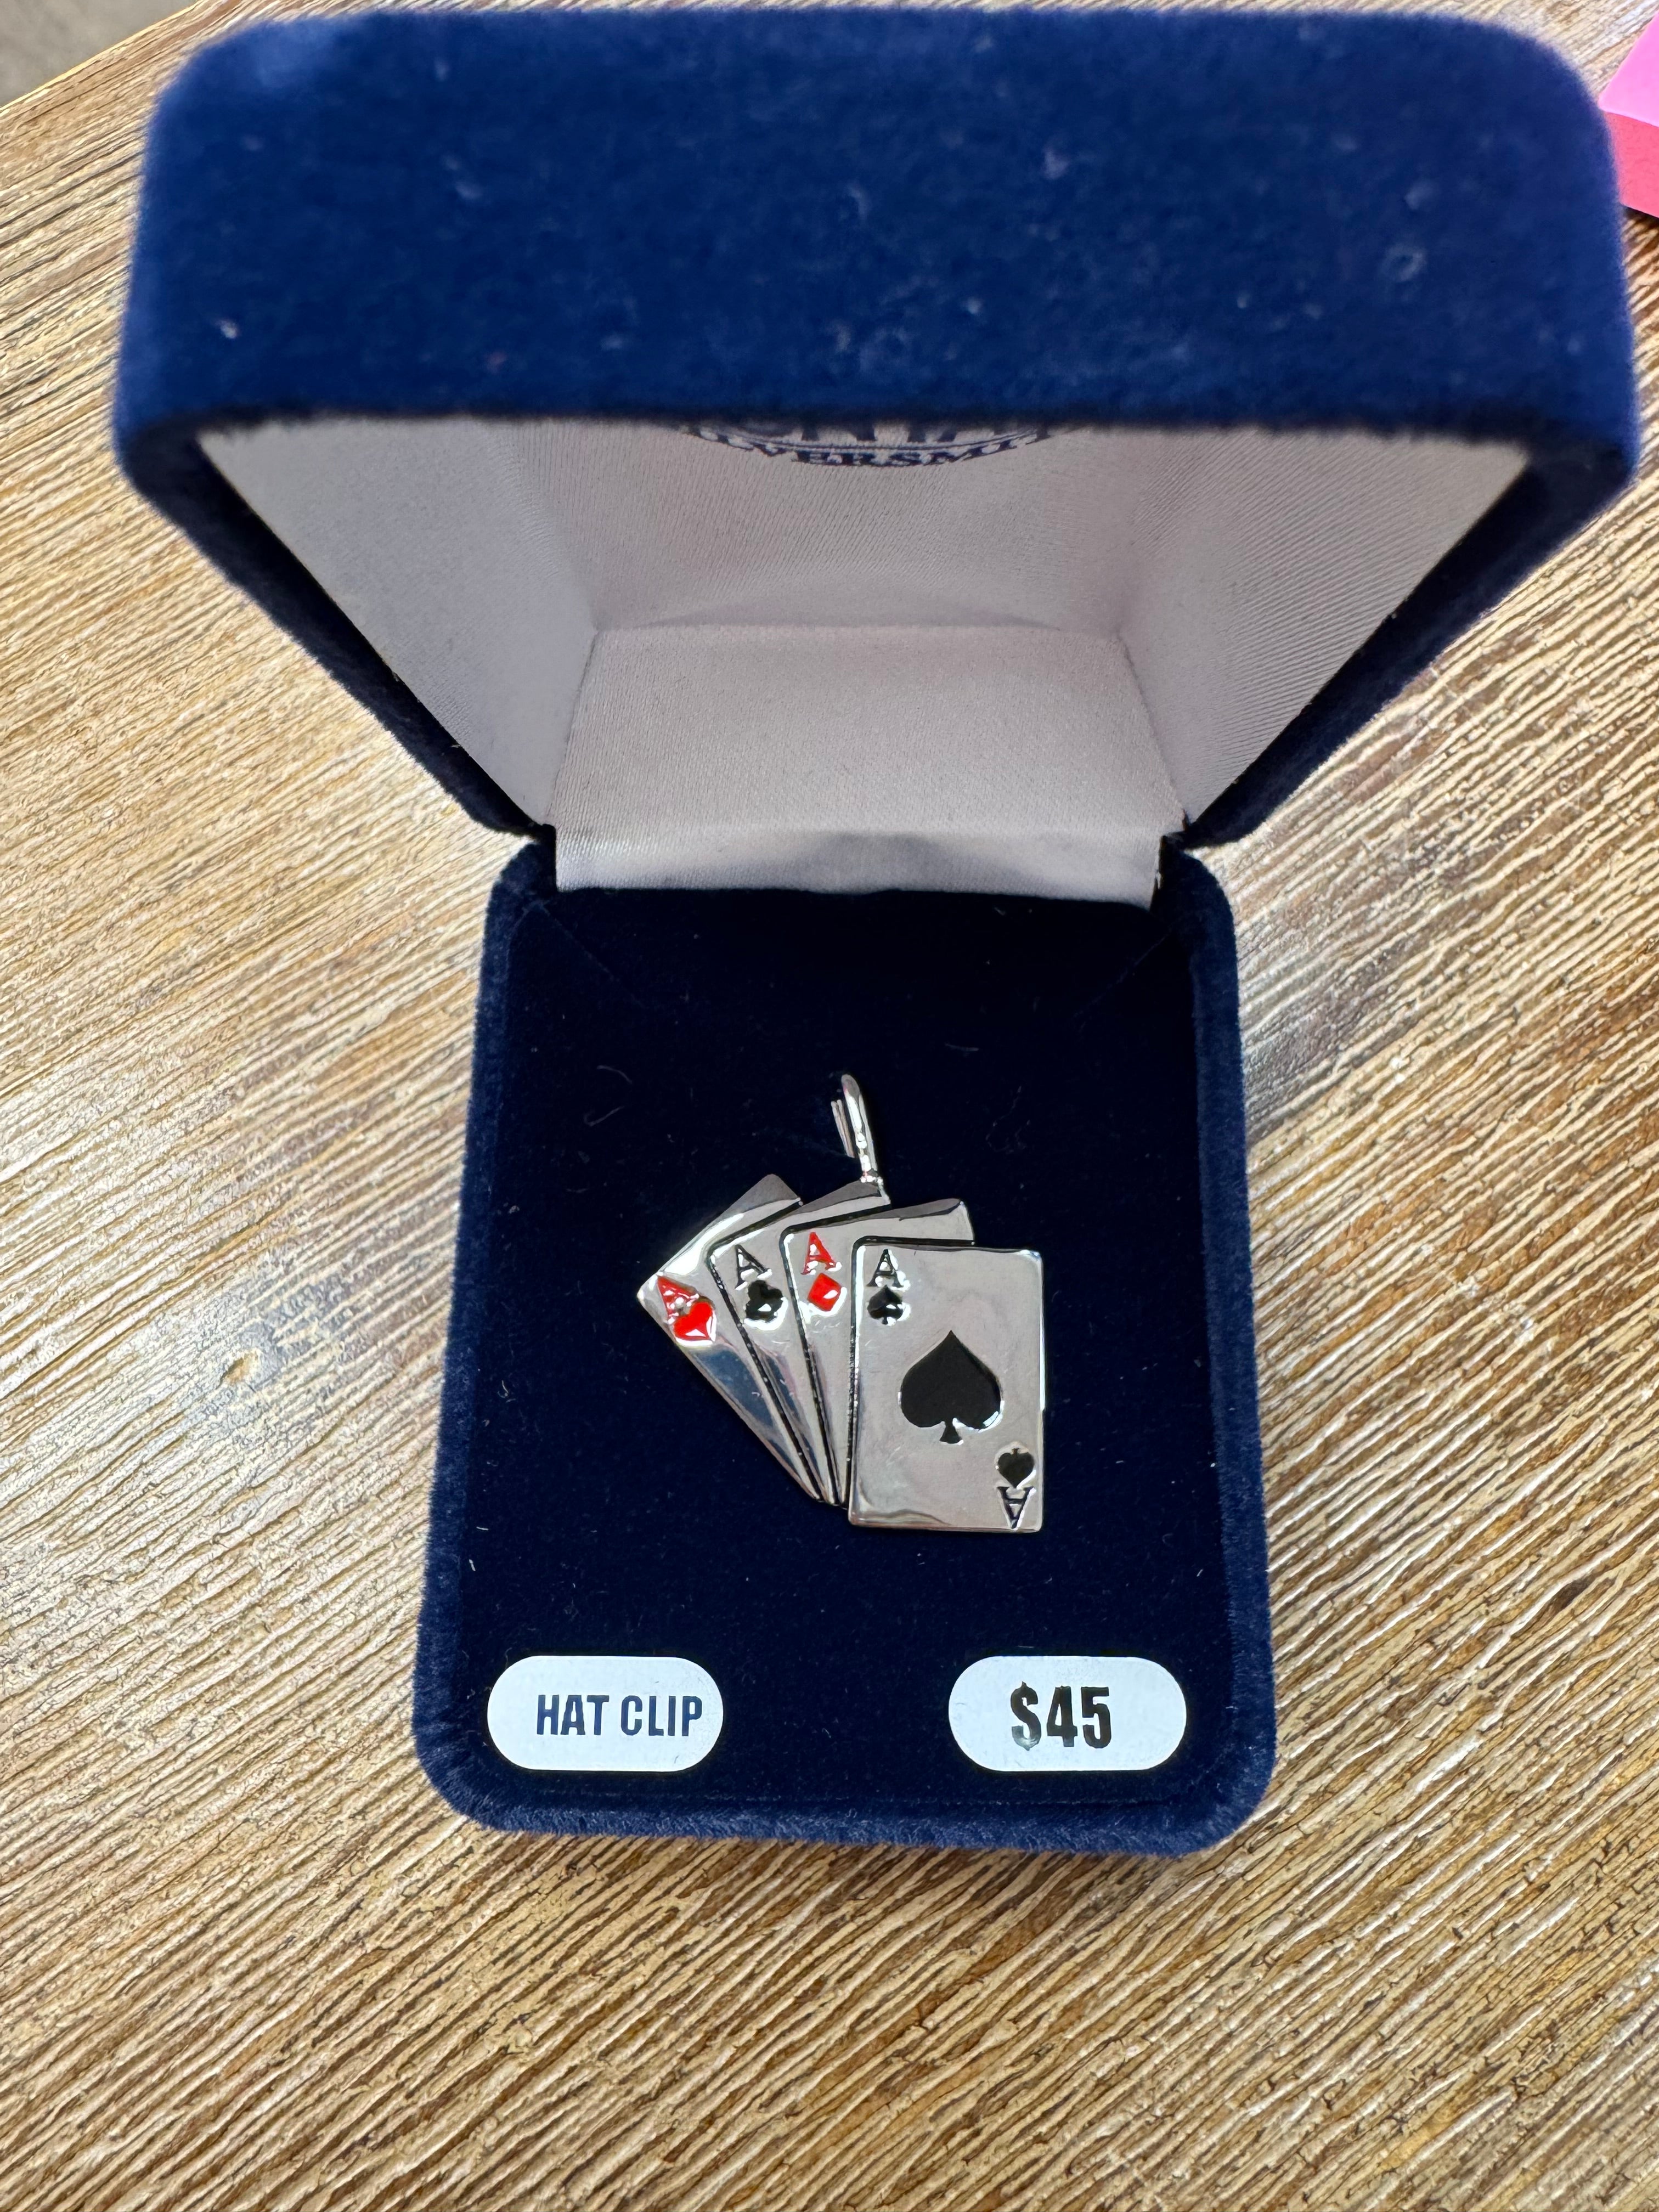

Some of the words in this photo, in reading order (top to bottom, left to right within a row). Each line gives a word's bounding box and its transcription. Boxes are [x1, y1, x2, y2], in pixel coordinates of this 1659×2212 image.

[735, 1244, 771, 1290] A
[802, 1232, 840, 1276] A
[866, 1249, 908, 1289] A
[657, 1276, 699, 1323] A
[996, 1486, 1036, 1530] A
[537, 1694, 610, 1736] HAT
[620, 1695, 703, 1737] CLIP
[1010, 1680, 1112, 1752] $45
